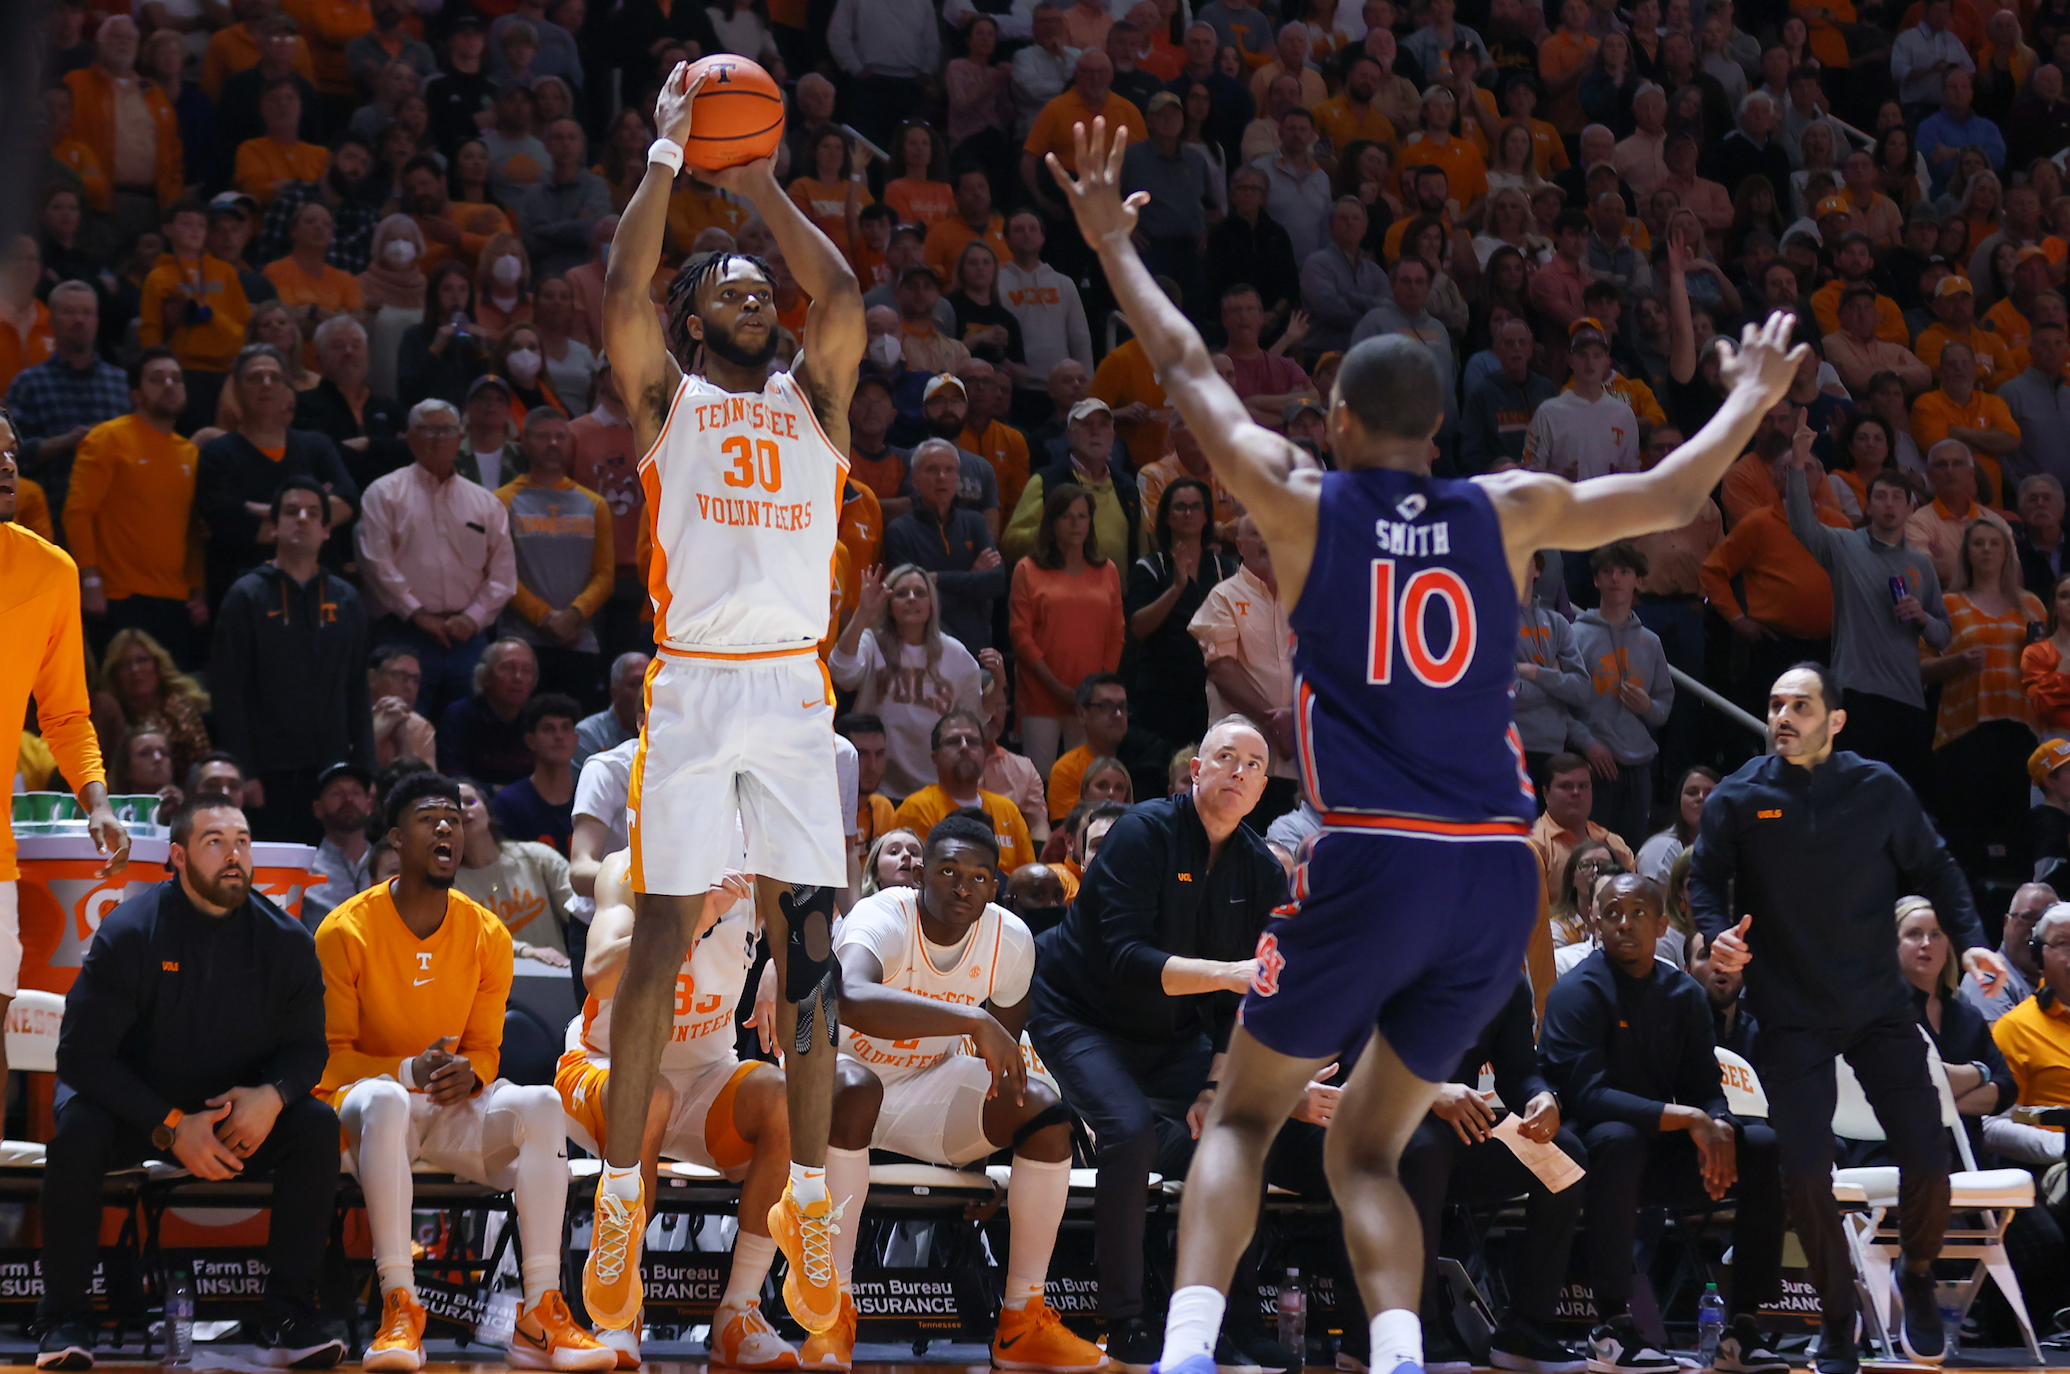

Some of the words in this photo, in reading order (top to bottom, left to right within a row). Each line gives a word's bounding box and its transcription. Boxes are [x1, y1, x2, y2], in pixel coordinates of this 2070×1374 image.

[710, 64, 736, 83] T
[1611, 427, 1624, 446] T
[721, 435, 782, 493] 30
[1375, 518, 1451, 557] SMITH
[1236, 602, 1251, 616] T
[1366, 557, 1478, 688] 10
[416, 952, 432, 970] T
[192, 1259, 243, 1276] Farm
[653, 1264, 719, 1280] Bureau
[196, 1278, 266, 1295] INSUR
[889, 1279, 953, 1295] Bureau
